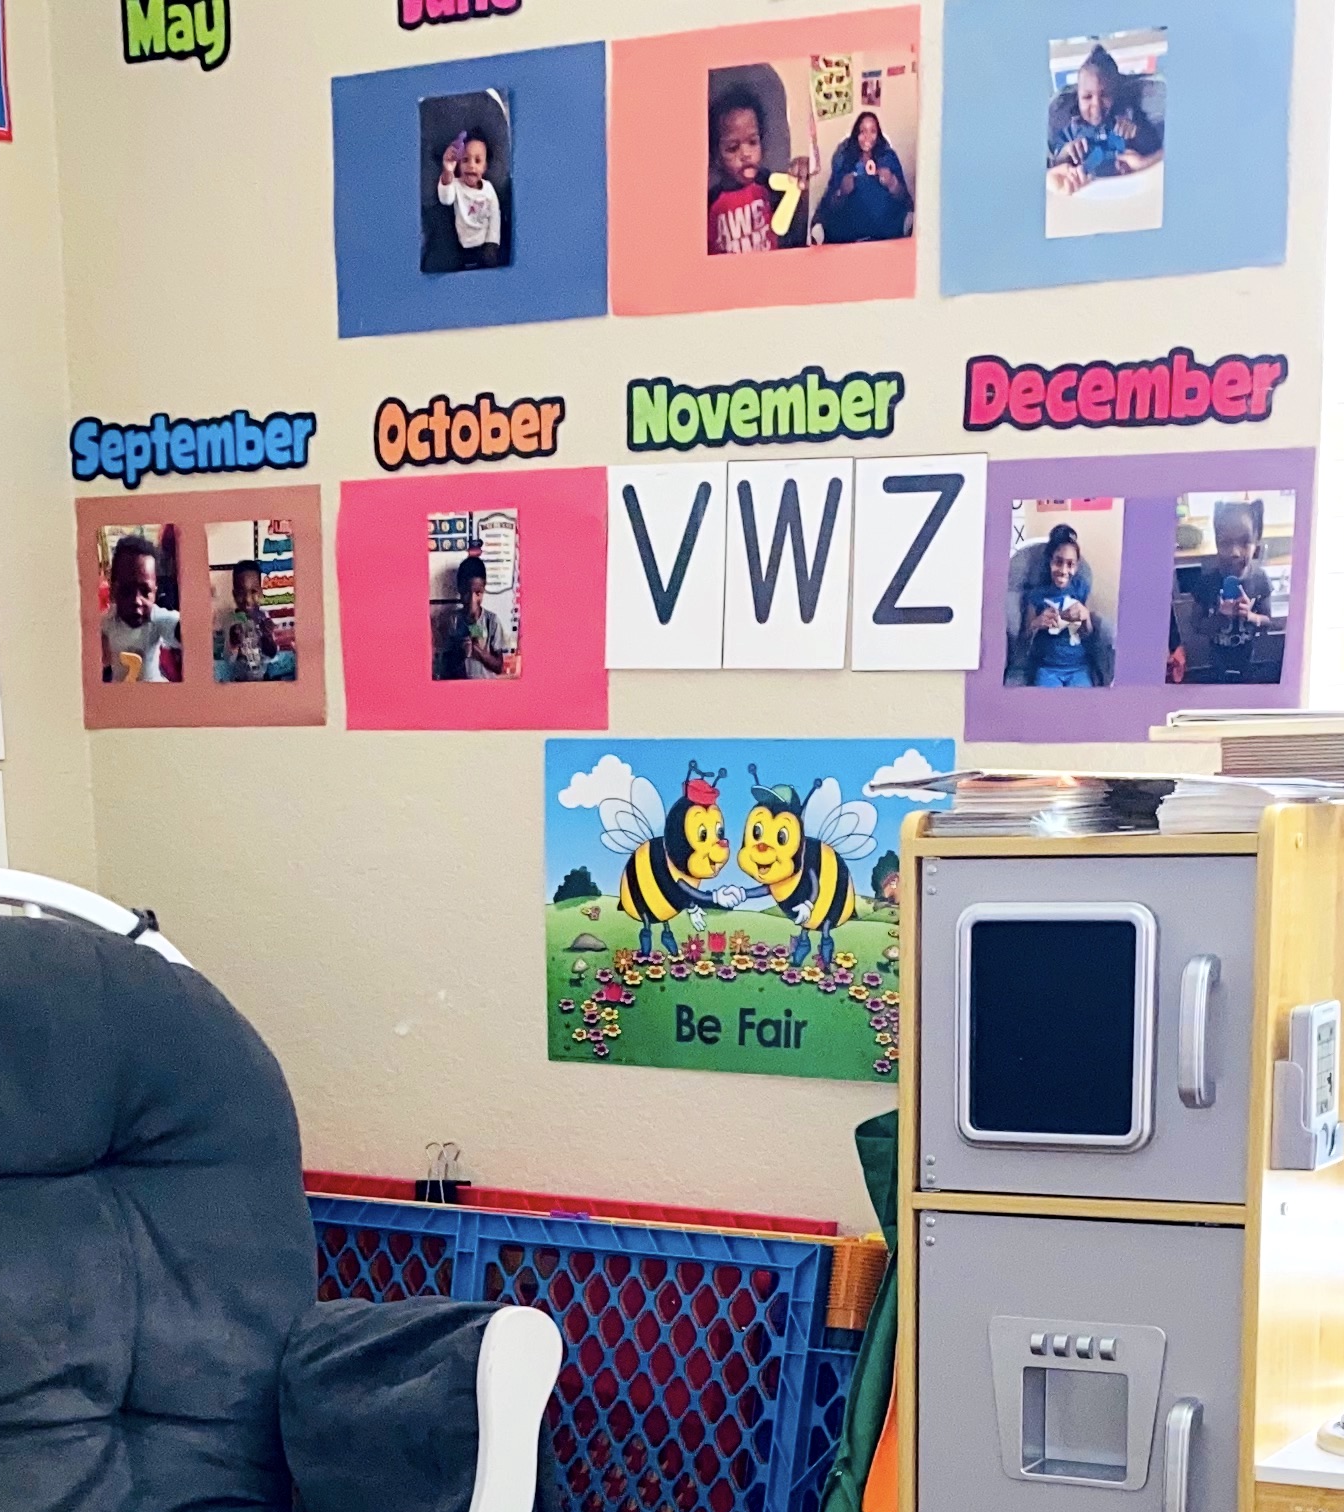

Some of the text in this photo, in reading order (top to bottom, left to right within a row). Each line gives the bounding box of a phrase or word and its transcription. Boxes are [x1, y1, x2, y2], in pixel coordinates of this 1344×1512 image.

[127, 0, 227, 66] May
[629, 369, 902, 450] November
[965, 348, 1287, 430] December
[73, 411, 315, 487] September
[377, 394, 563, 468] October
[623, 481, 711, 626] V
[737, 477, 843, 625] W
[872, 473, 965, 624] Z
[675, 1004, 808, 1049] Be Fair
